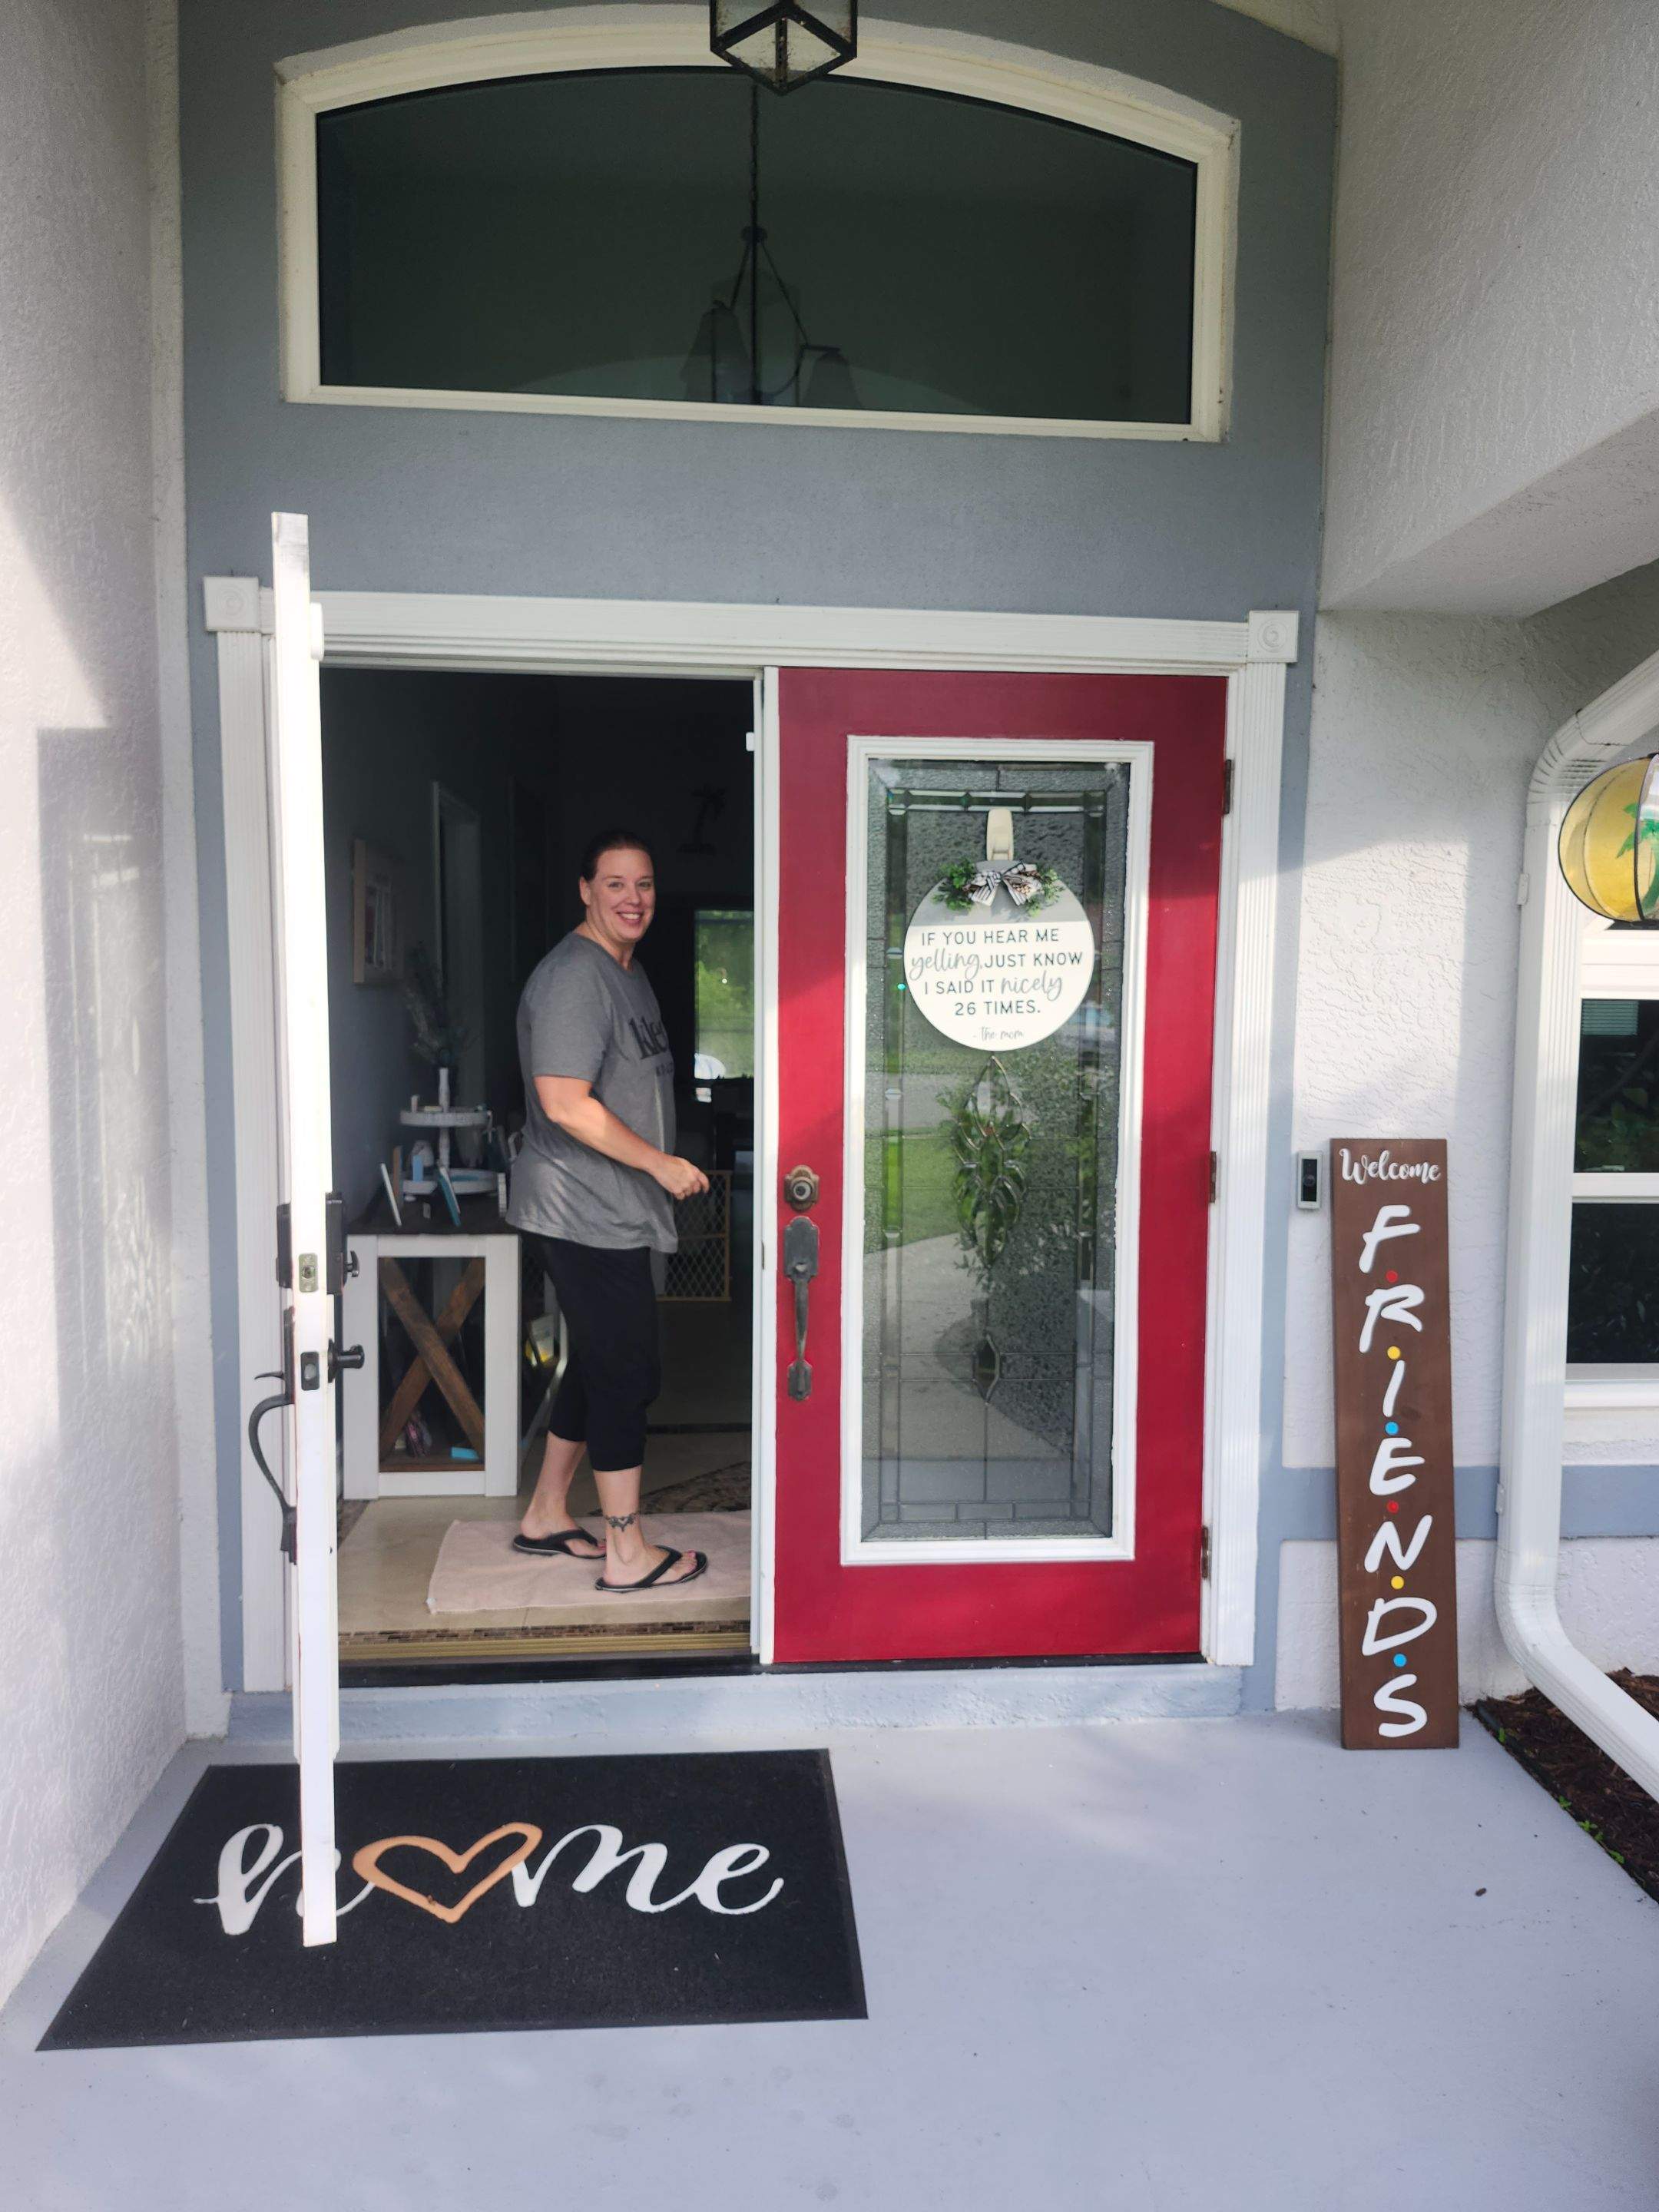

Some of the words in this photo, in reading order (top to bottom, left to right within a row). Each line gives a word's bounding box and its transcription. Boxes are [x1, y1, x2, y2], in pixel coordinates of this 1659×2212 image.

[921, 932, 936, 946] IF
[942, 931, 976, 945] YOU
[983, 929, 1028, 944] HEAR
[1035, 928, 1060, 942] ME
[985, 953, 1025, 969] JUST
[1033, 951, 1083, 967] KNOW
[935, 980, 974, 995] SAID
[981, 979, 995, 993] IT
[1000, 970, 1063, 1002] nicely
[954, 1002, 977, 1016] 26
[983, 1000, 1041, 1015] TIMES.
[1000, 1030, 1025, 1040] mom
[1339, 1147, 1441, 1185] Welcome
